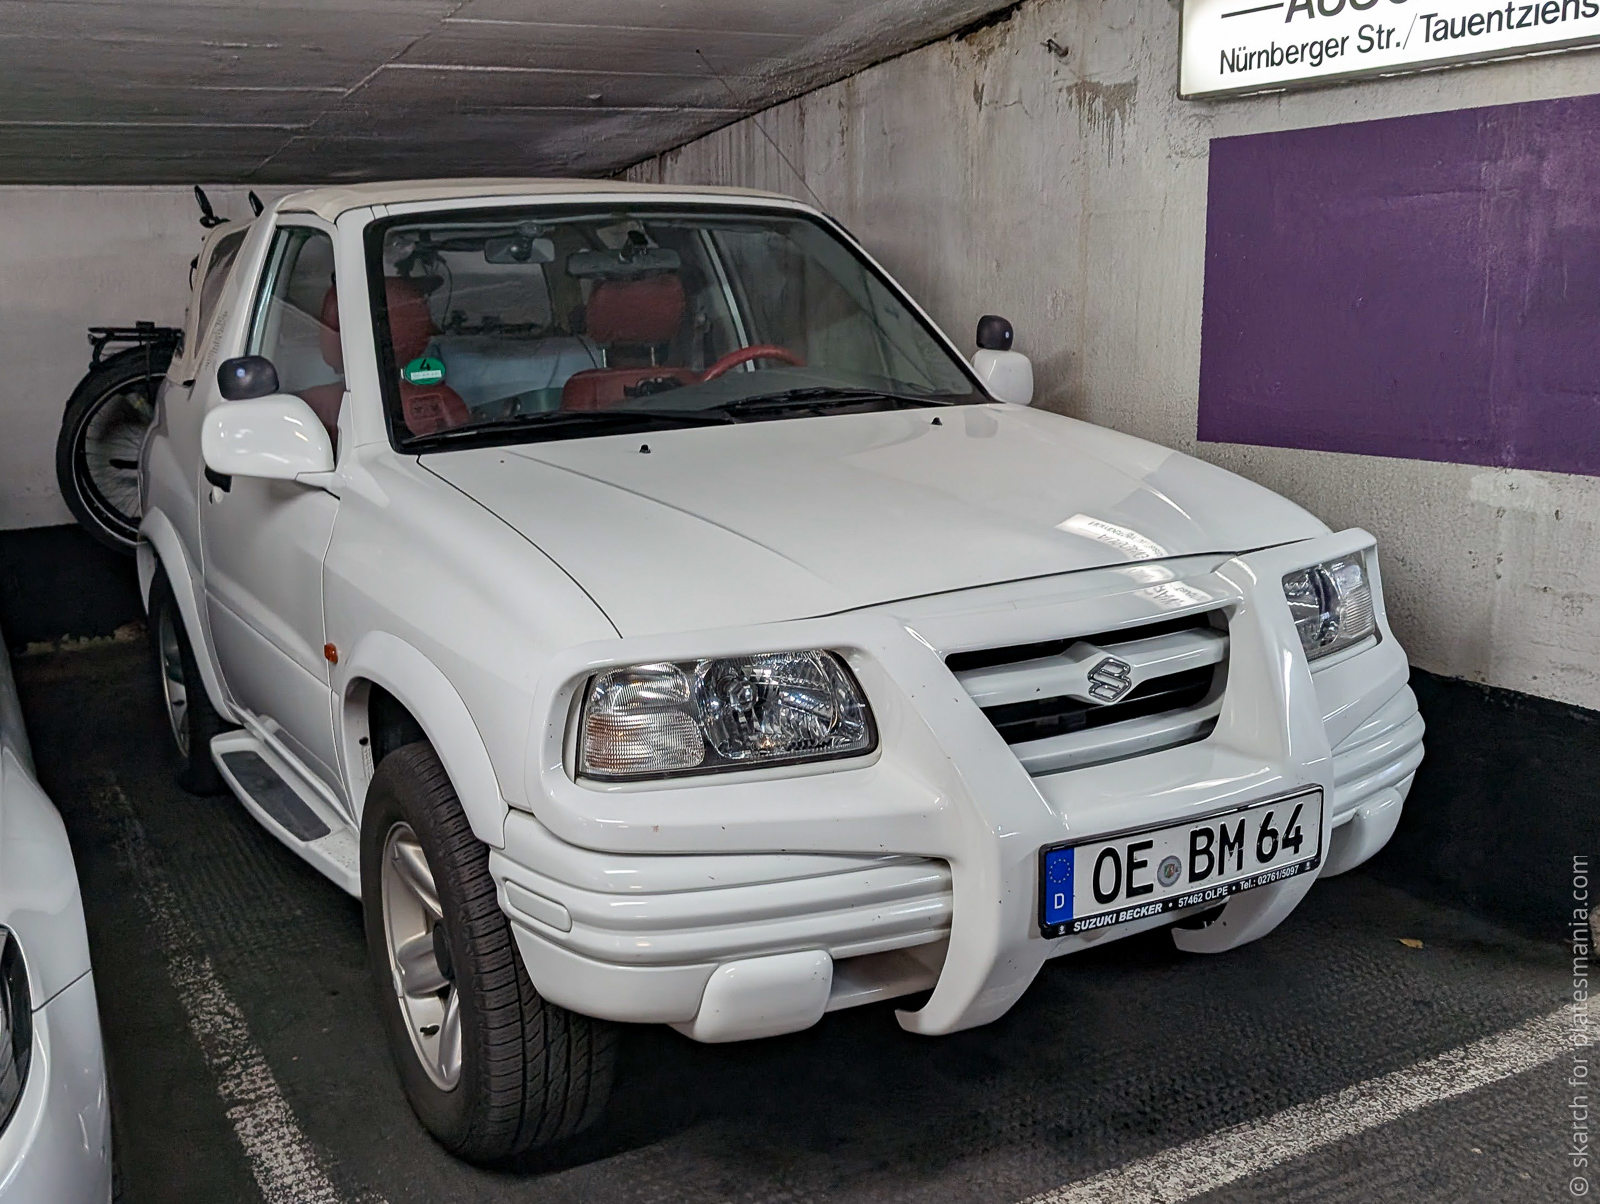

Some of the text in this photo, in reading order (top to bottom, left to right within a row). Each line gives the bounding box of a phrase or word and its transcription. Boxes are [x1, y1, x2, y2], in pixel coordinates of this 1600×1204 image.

[1219, 35, 1350, 75] Nürnberger
[420, 358, 431, 371] 4
[1092, 803, 1304, 905] OE BM 64
[1054, 892, 1066, 910] D
[1073, 865, 1300, 932] SUZUKI BECKER 57462 OLPE Tel.: 02761/5097
